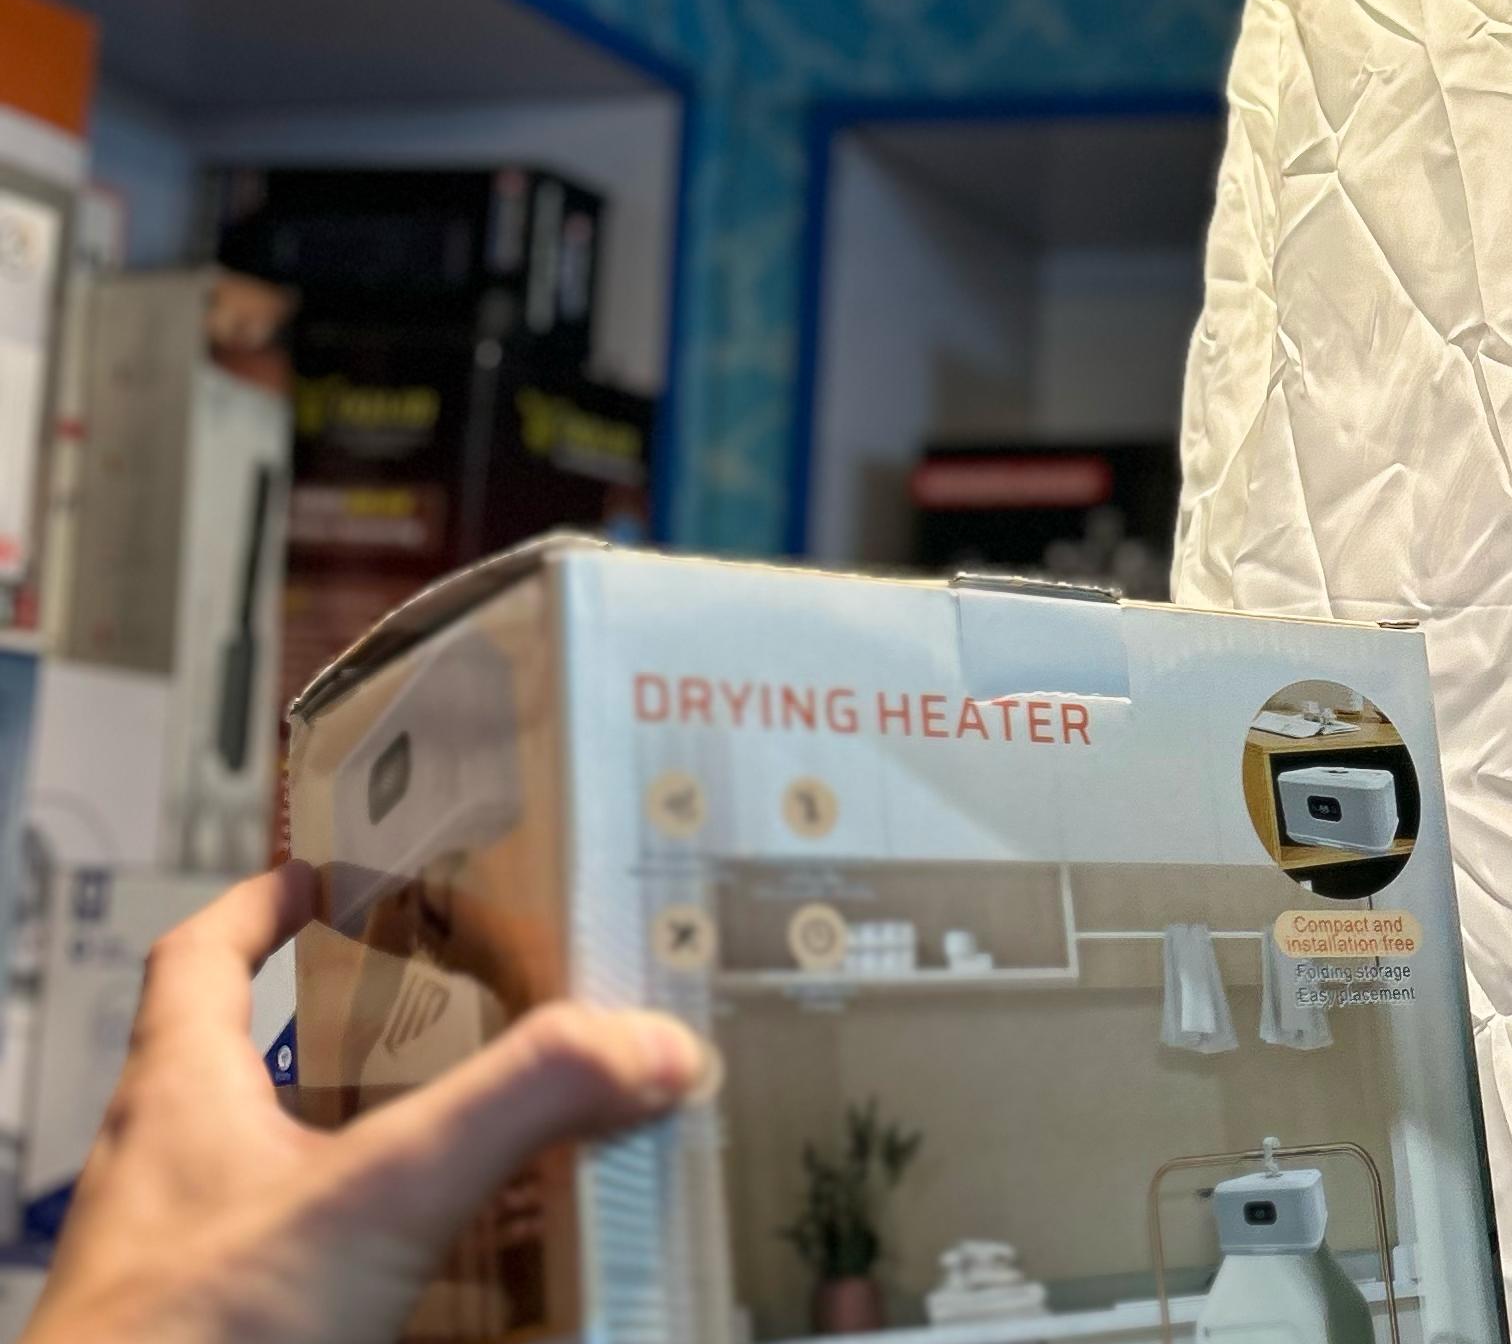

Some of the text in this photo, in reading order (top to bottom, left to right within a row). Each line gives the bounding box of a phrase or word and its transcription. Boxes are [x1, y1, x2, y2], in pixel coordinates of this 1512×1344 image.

[633, 672, 1091, 746] DRYING HEATER
[1294, 915, 1403, 937] Compact and
[1286, 935, 1415, 952] installation free
[1296, 964, 1411, 982] Folding storage
[1297, 987, 1416, 1008] Easy placement
